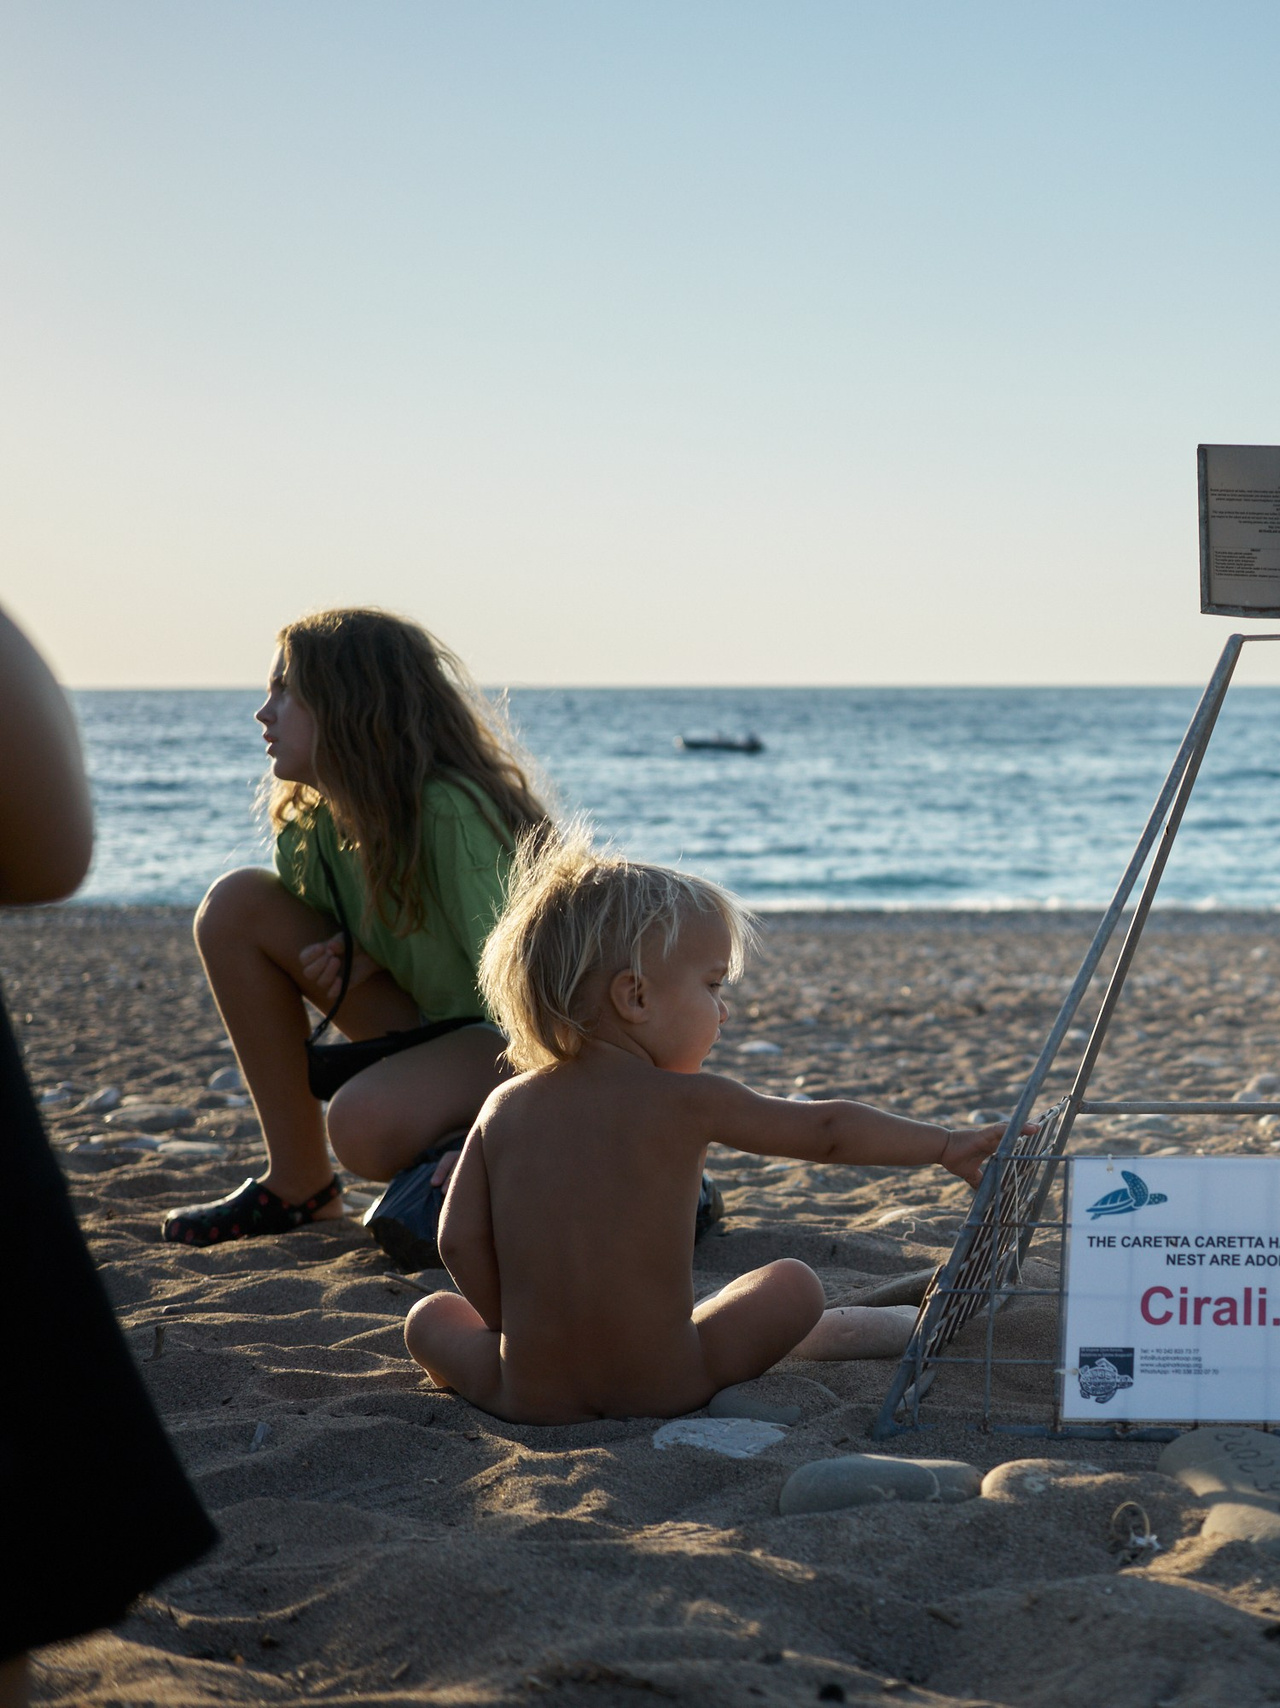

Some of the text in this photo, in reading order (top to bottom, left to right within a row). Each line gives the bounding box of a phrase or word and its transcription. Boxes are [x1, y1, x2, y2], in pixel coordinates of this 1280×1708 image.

[1087, 1236, 1116, 1247] THE
[1121, 1236, 1191, 1248] CARETTA
[1195, 1236, 1265, 1249] CARETTA
[1166, 1254, 1206, 1265] NEST
[1209, 1254, 1241, 1266] ARE
